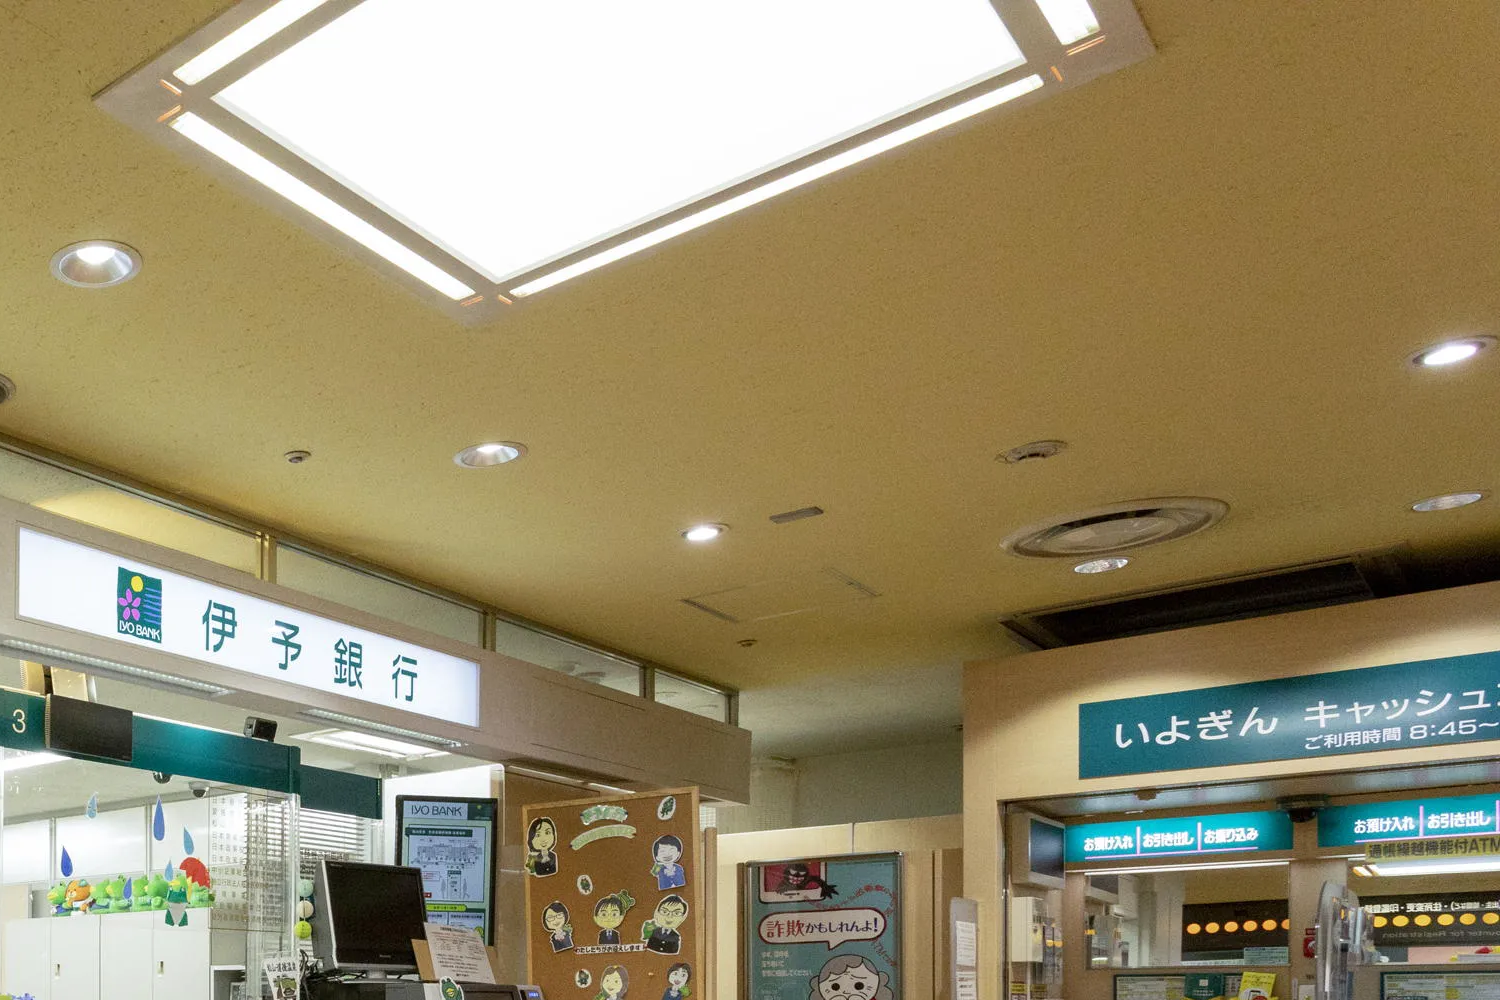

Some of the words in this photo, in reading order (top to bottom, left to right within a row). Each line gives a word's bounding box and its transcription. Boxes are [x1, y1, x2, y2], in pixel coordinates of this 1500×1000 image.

[119, 620, 135, 634] IYO
[136, 625, 162, 641] BANK
[202, 600, 418, 702] 伊予銀行
[12, 708, 27, 736] 3
[1115, 707, 1278, 750] いよぎん
[1304, 687, 1500, 729] キャッシュ
[1304, 726, 1402, 751] ご利用時間
[411, 805, 430, 815] IYO
[431, 806, 462, 816] BANK
[1353, 816, 1415, 834] お預け入れ
[1427, 810, 1492, 829] お引き出し
[1084, 836, 1134, 852] お預け入れ
[1142, 832, 1194, 848] お引き出し
[1203, 828, 1259, 844] お振り込み
[766, 917, 878, 938] 詐欺かもしれんよ!
